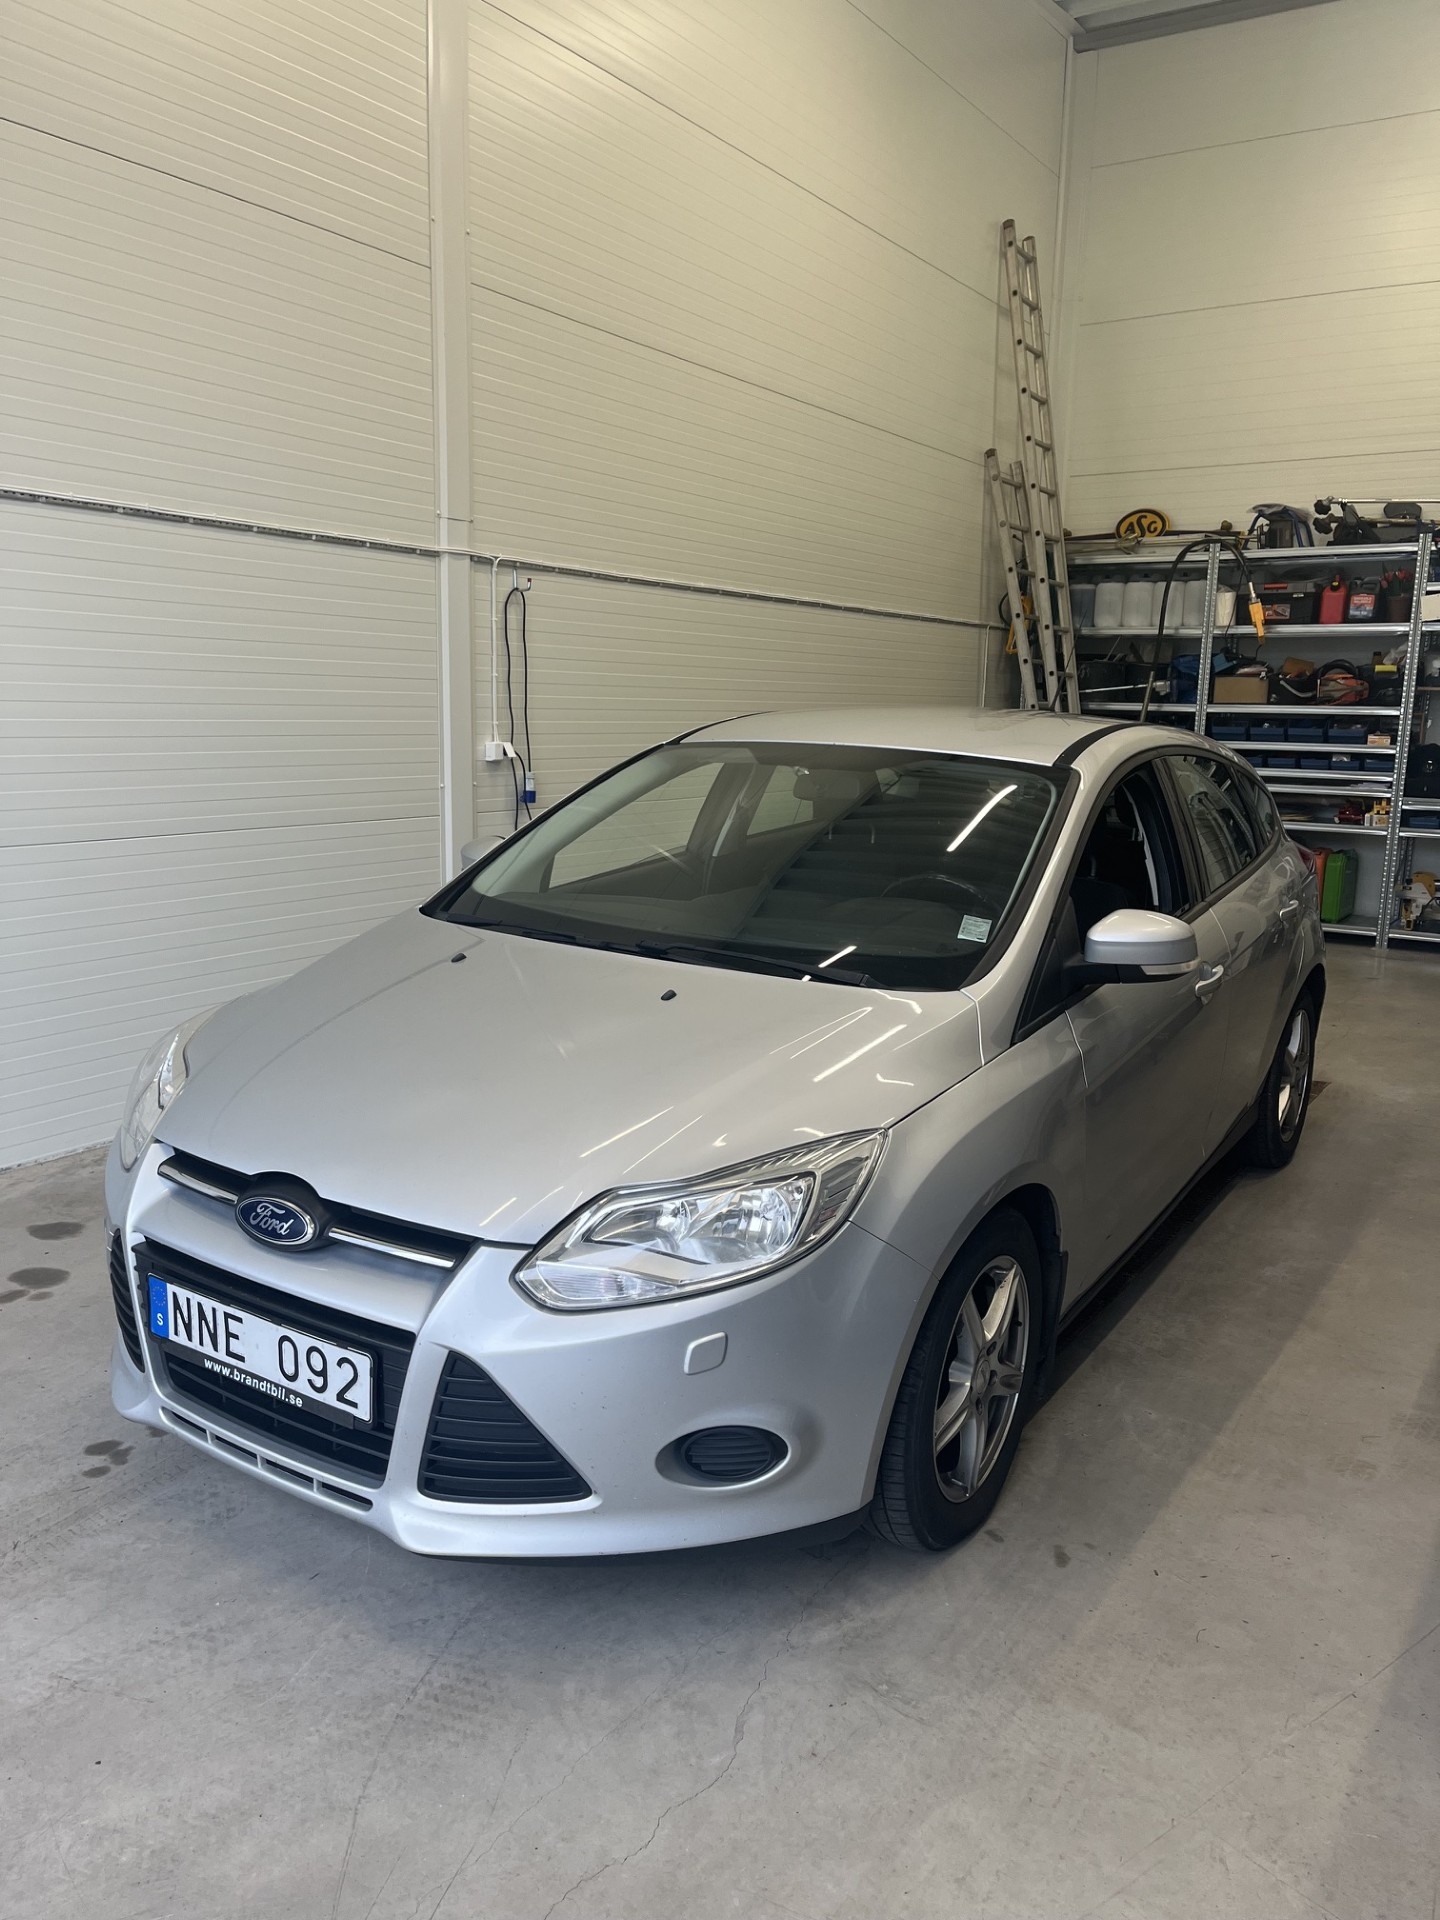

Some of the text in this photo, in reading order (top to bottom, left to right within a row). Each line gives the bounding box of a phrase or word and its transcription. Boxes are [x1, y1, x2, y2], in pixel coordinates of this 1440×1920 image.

[249, 1202, 295, 1236] Ford
[156, 1312, 164, 1326] S
[172, 1291, 359, 1410] NNE 092
[203, 1357, 303, 1408] www.brandtbil.se
